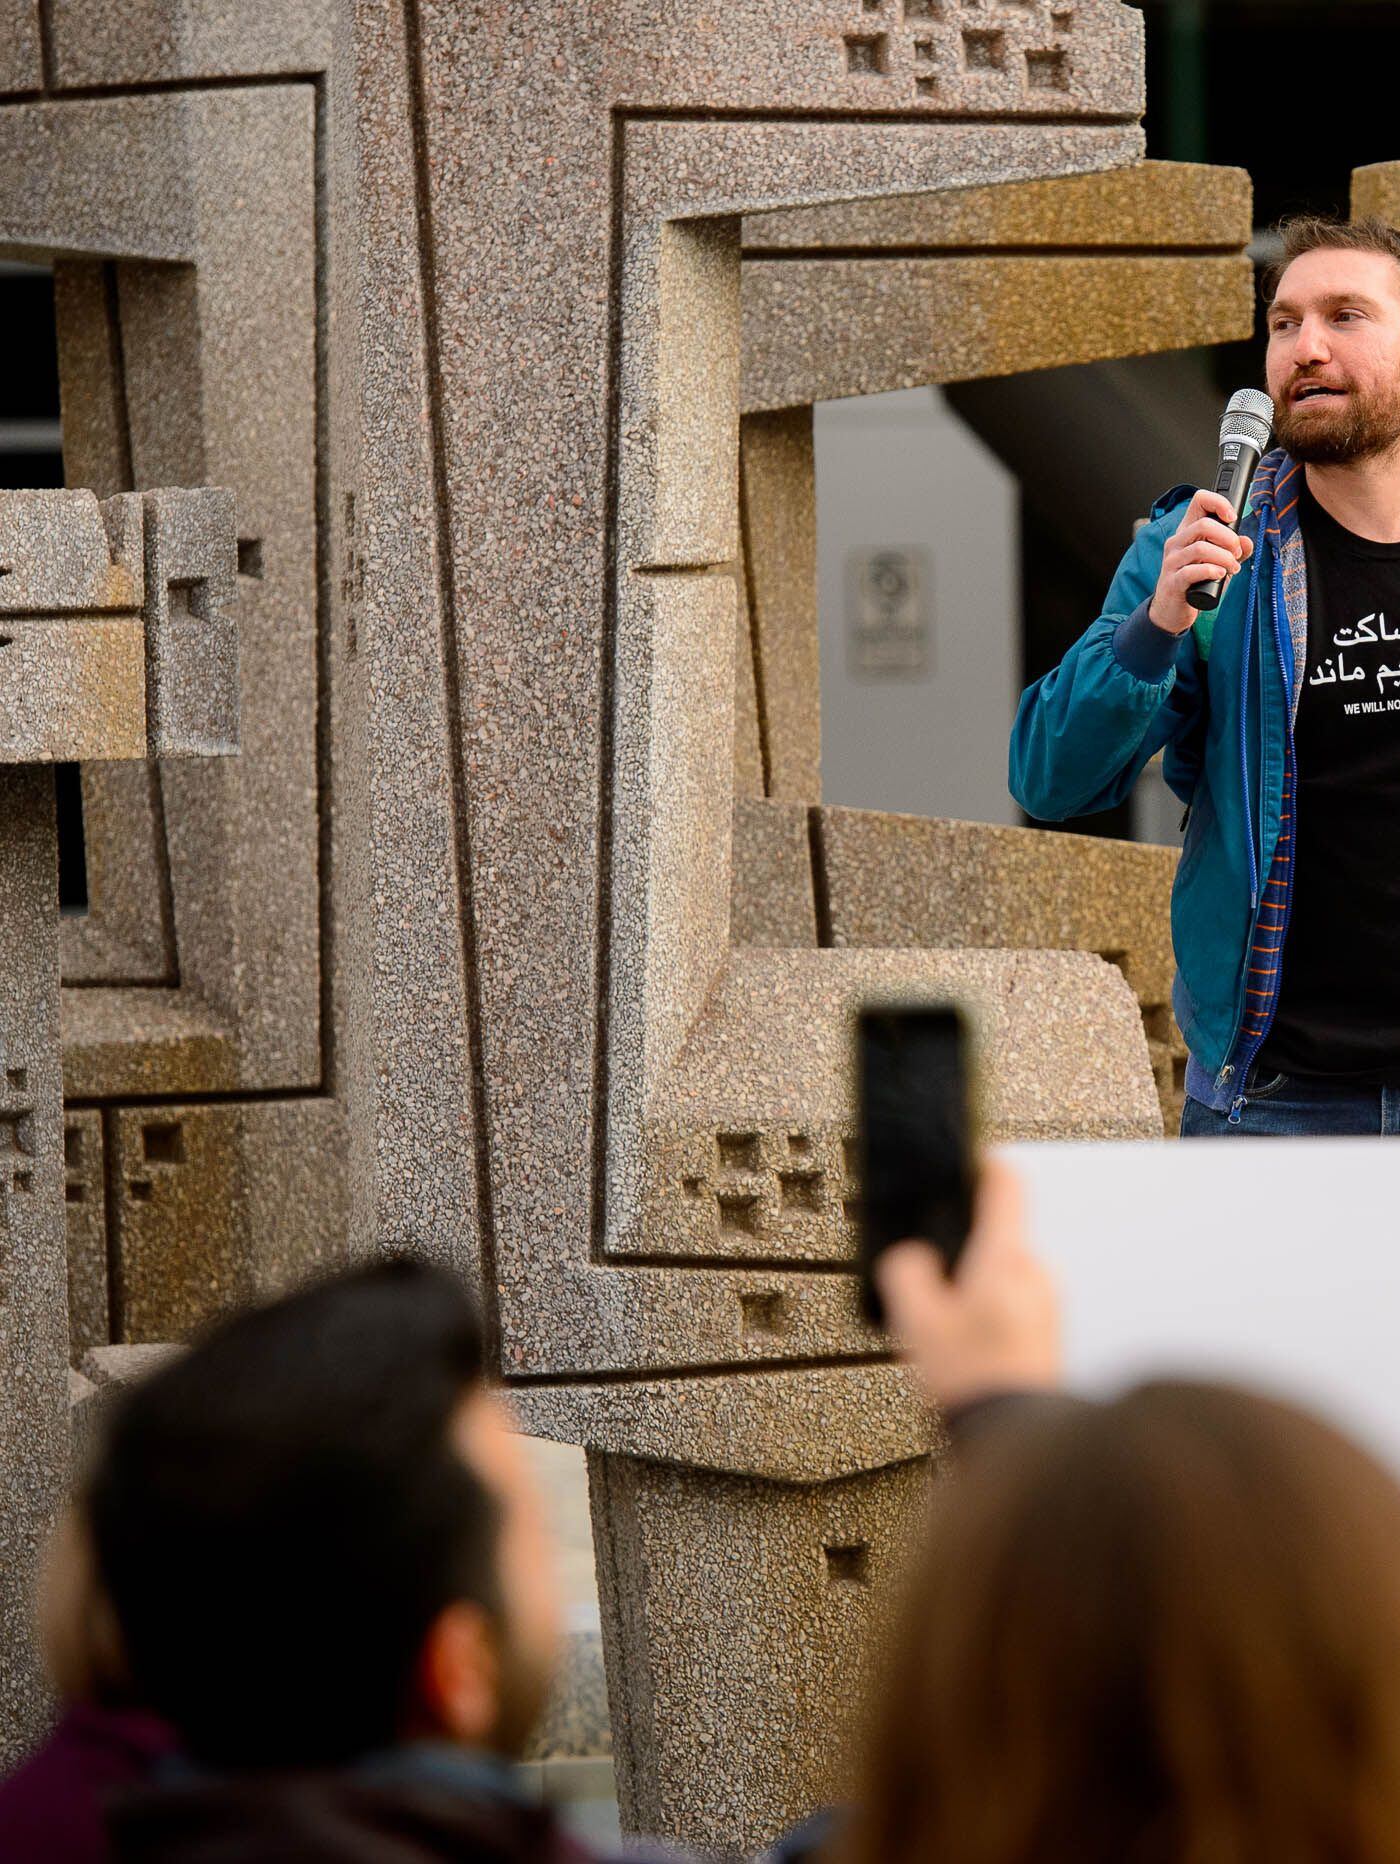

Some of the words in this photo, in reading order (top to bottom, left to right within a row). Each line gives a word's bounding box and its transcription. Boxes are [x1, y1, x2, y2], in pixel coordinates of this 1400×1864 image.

[1309, 652, 1366, 686] ماند
[1343, 703, 1361, 715] WE
[1361, 701, 1386, 713] WILL
